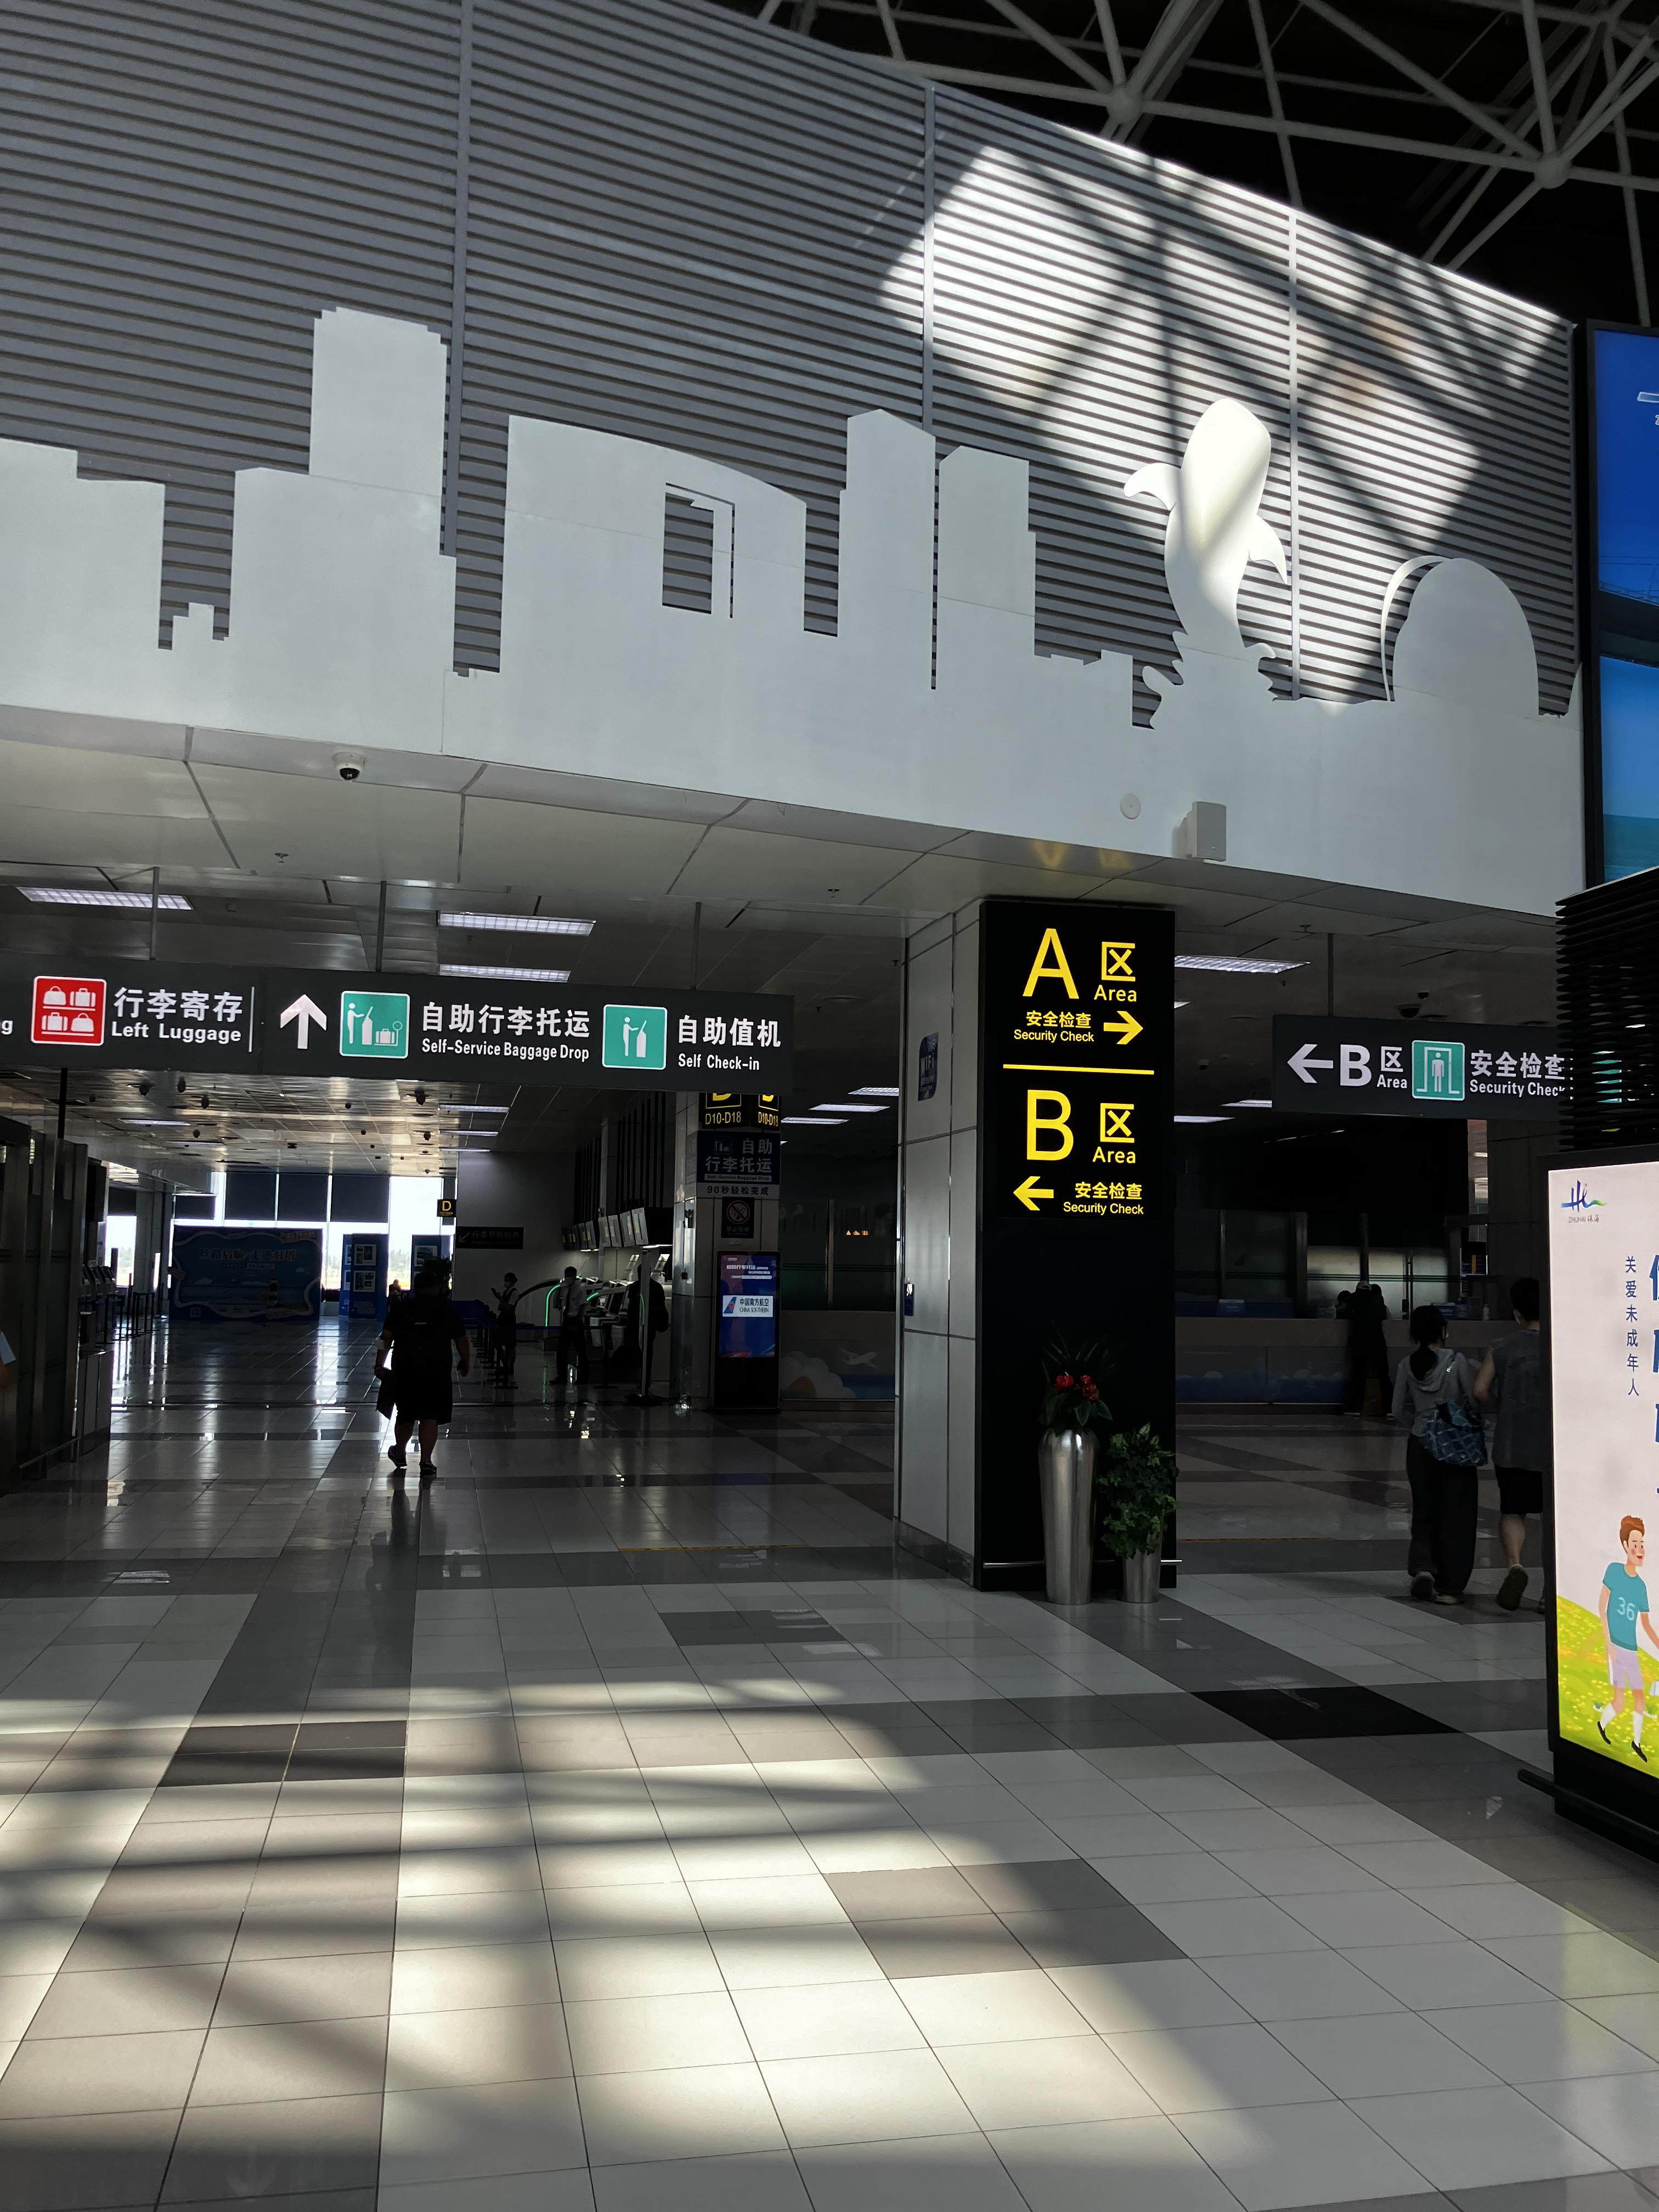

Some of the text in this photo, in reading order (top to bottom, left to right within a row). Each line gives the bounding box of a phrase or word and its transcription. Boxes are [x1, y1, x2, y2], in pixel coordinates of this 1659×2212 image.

[1023, 928, 1136, 999] A 区
[1094, 985, 1136, 1002] Area
[112, 987, 242, 1023] 行李寄存
[423, 1002, 589, 1037] 自助行李托运
[1026, 1011, 1091, 1028] 安全检查
[112, 1022, 241, 1044] Left Luggage
[679, 1015, 781, 1047] 自助值机
[1014, 1029, 1094, 1043] Security Check
[422, 1039, 589, 1062] Self-Service Baggage Drop
[679, 1053, 759, 1070] Self Check-in
[1340, 1045, 1403, 1086] B 区
[1471, 1050, 1565, 1080] 安全检查
[1377, 1075, 1407, 1088] Area
[1470, 1080, 1524, 1097] Security
[706, 1111, 741, 1124] D10-D18
[758, 1111, 778, 1126] D10-D18
[1027, 1090, 1135, 1160] B 区
[743, 1138, 772, 1154] 自助
[1093, 1147, 1135, 1163] Area
[706, 1156, 771, 1172] 行李托运
[707, 1186, 769, 1195] 90秒轻松完成
[1075, 1182, 1142, 1199] 安全检查
[442, 1200, 452, 1212] D
[1064, 1202, 1143, 1215] Security Check
[740, 1298, 769, 1306] 中国南方航空
[1626, 1256, 1639, 1396] 关爱未成年人
[1617, 1597, 1635, 1621] 36
